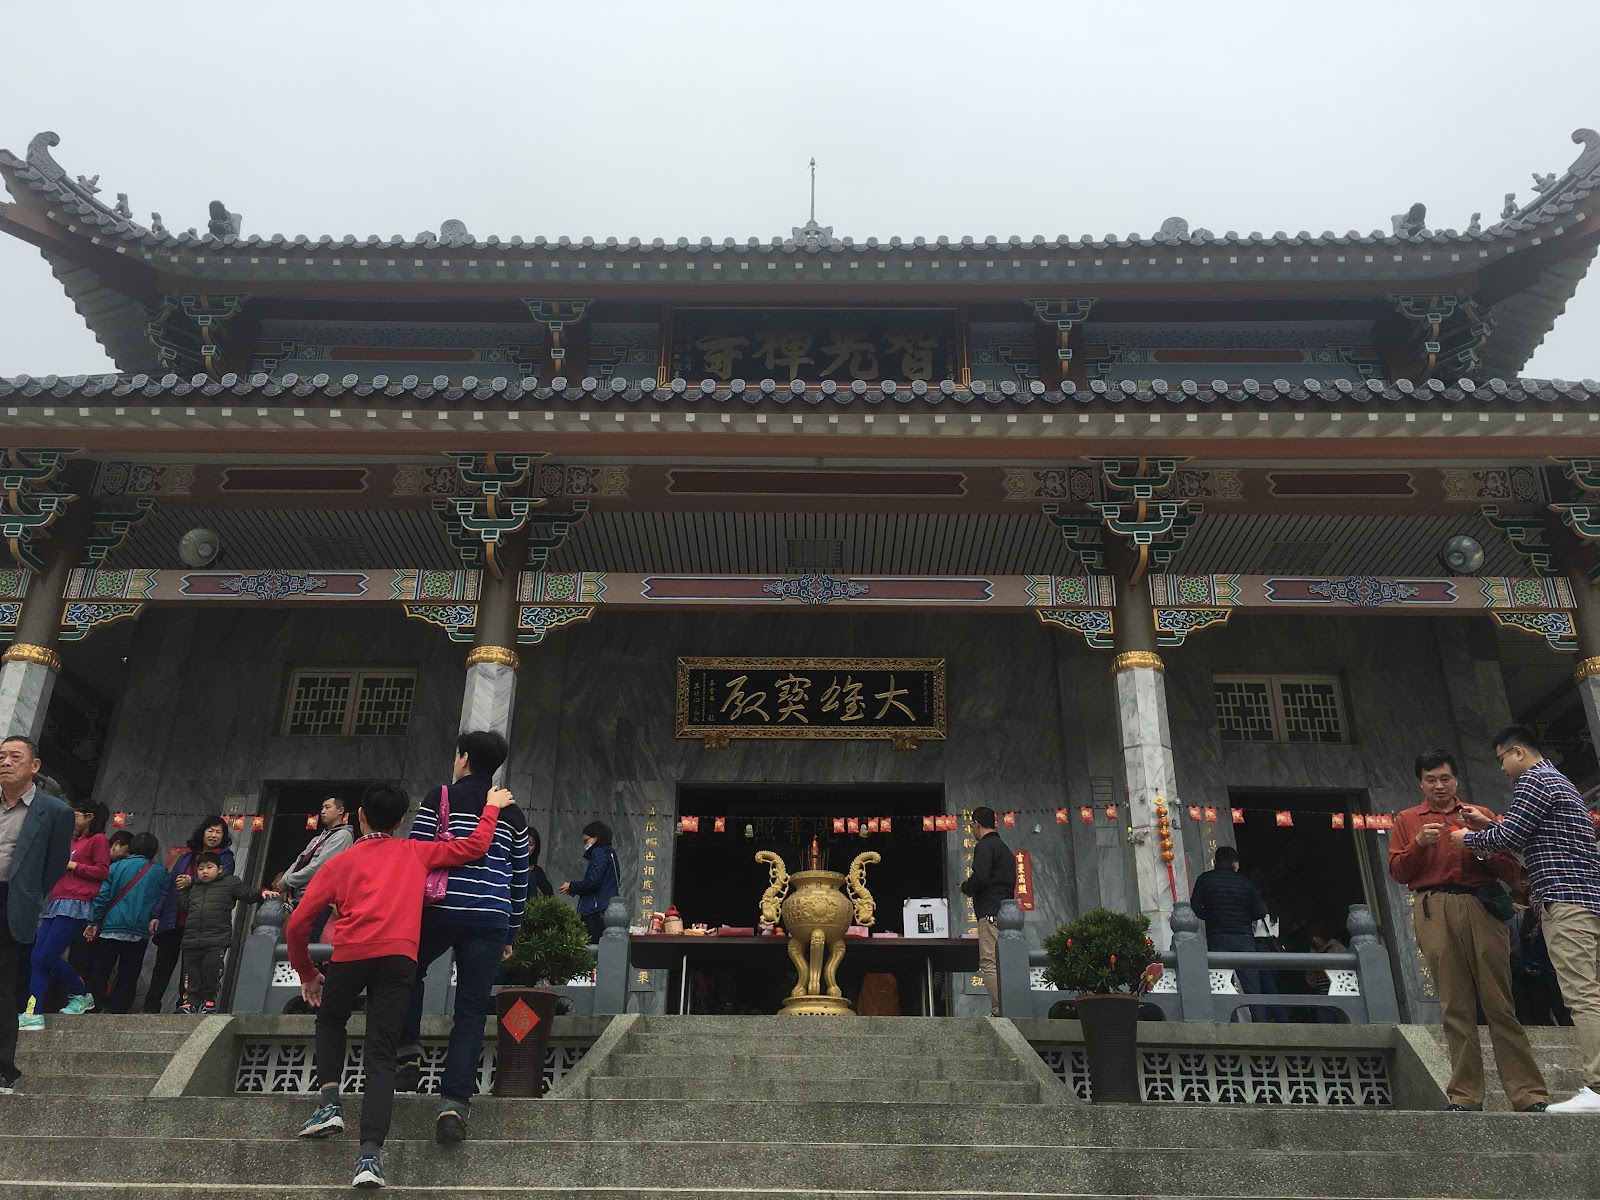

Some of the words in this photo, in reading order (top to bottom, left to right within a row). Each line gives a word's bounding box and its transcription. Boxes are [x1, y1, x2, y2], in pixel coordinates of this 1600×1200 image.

[694, 329, 939, 380] 智光禪寺
[720, 672, 917, 724] 大雄寶殿
[1016, 852, 1028, 894] 吉星高照
[509, 1006, 531, 1031] 福
